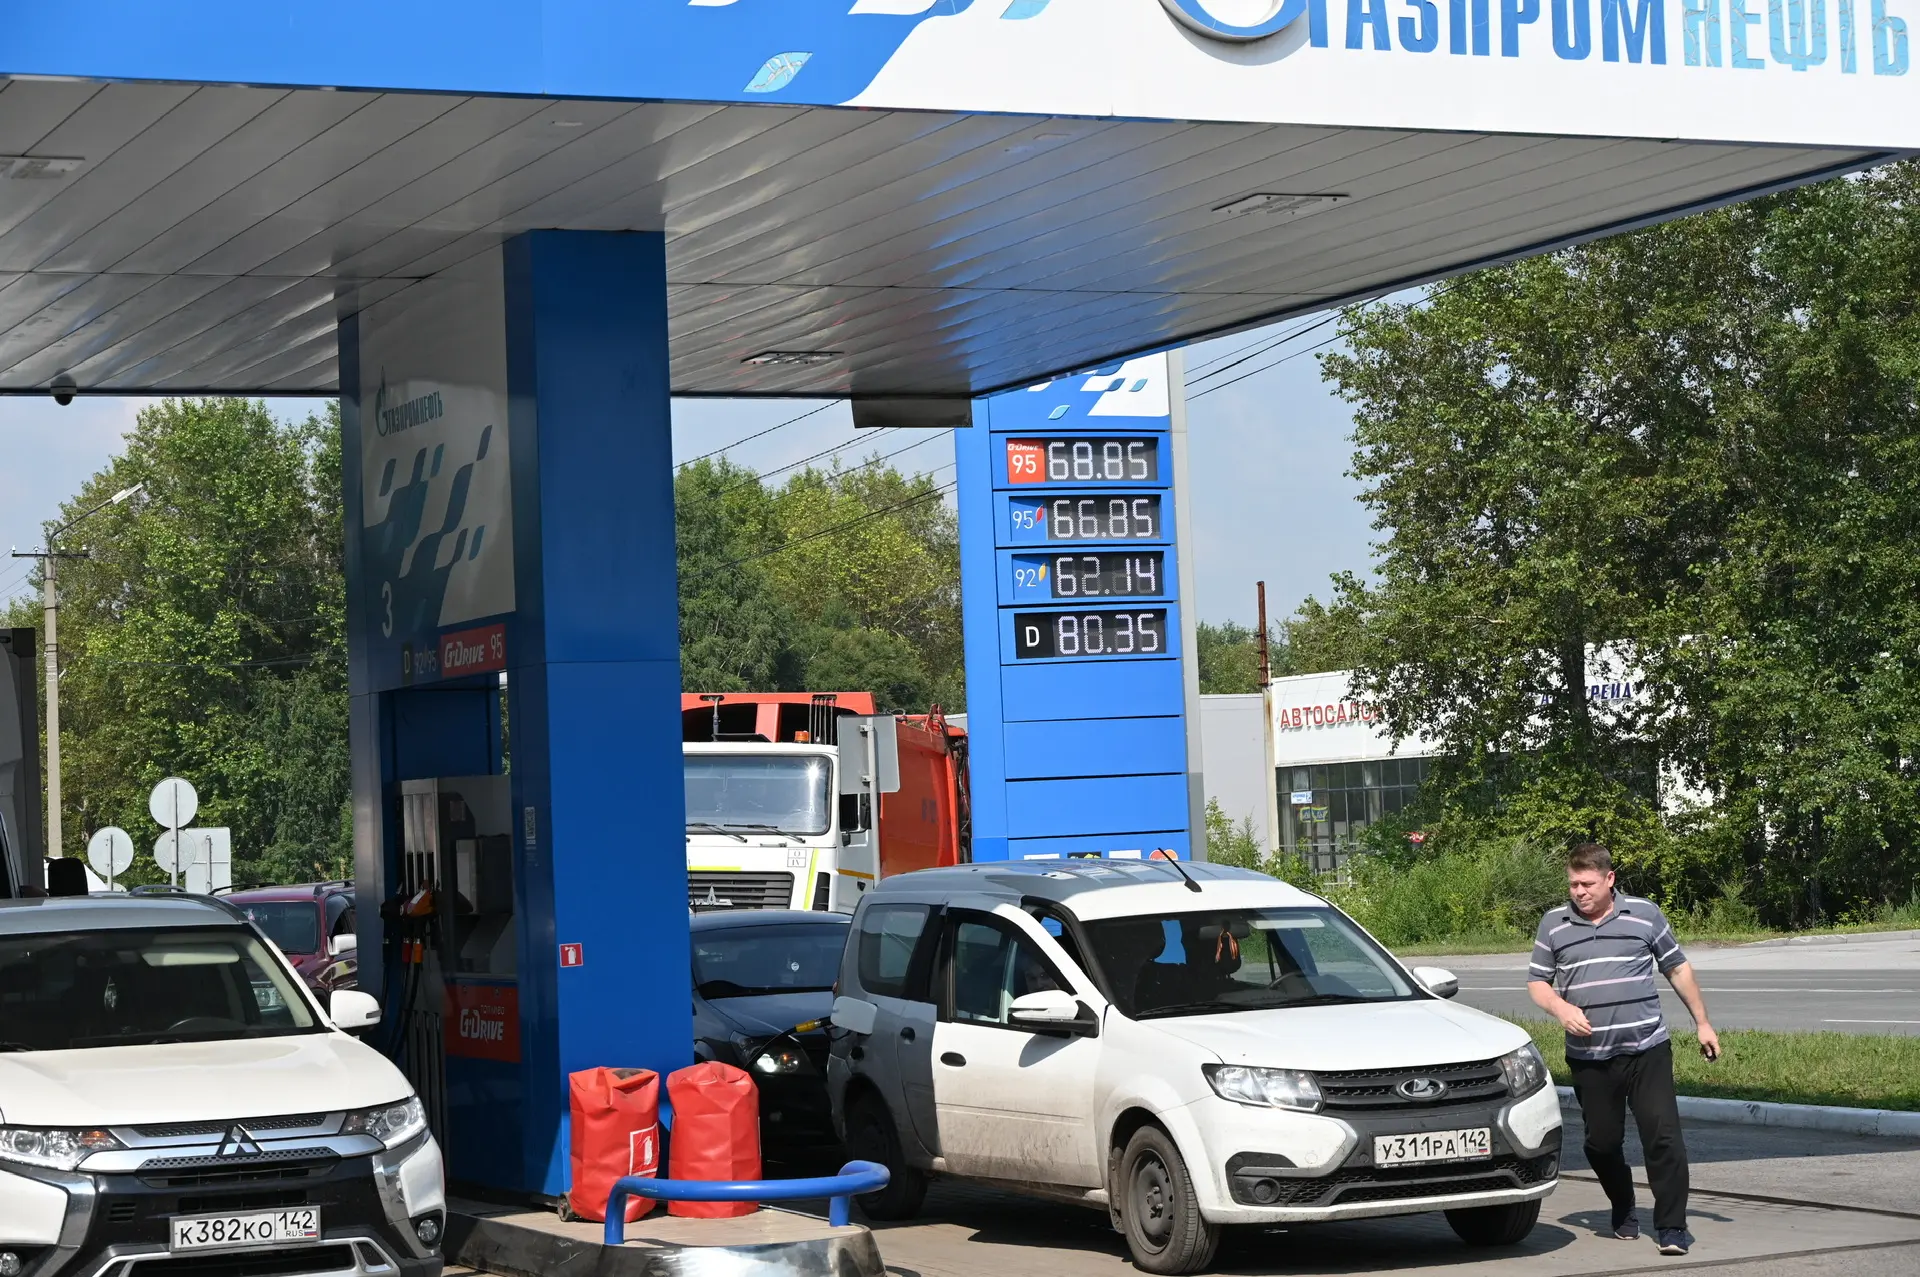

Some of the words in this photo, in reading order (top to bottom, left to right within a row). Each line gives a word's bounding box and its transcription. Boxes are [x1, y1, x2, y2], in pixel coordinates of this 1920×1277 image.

[1012, 454, 1037, 474] 95
[1048, 441, 1148, 480] 68.85
[1012, 510, 1034, 530] 95
[1053, 499, 1153, 537] 66.85
[1015, 568, 1037, 588] 92
[1056, 557, 1156, 595] 62.14
[381, 580, 393, 638] 3
[1025, 626, 1040, 648] D
[1058, 613, 1158, 655] 80.35
[1459, 1130, 1486, 1148] 142
[278, 1211, 313, 1231] 142
[285, 1229, 304, 1238] RUS
